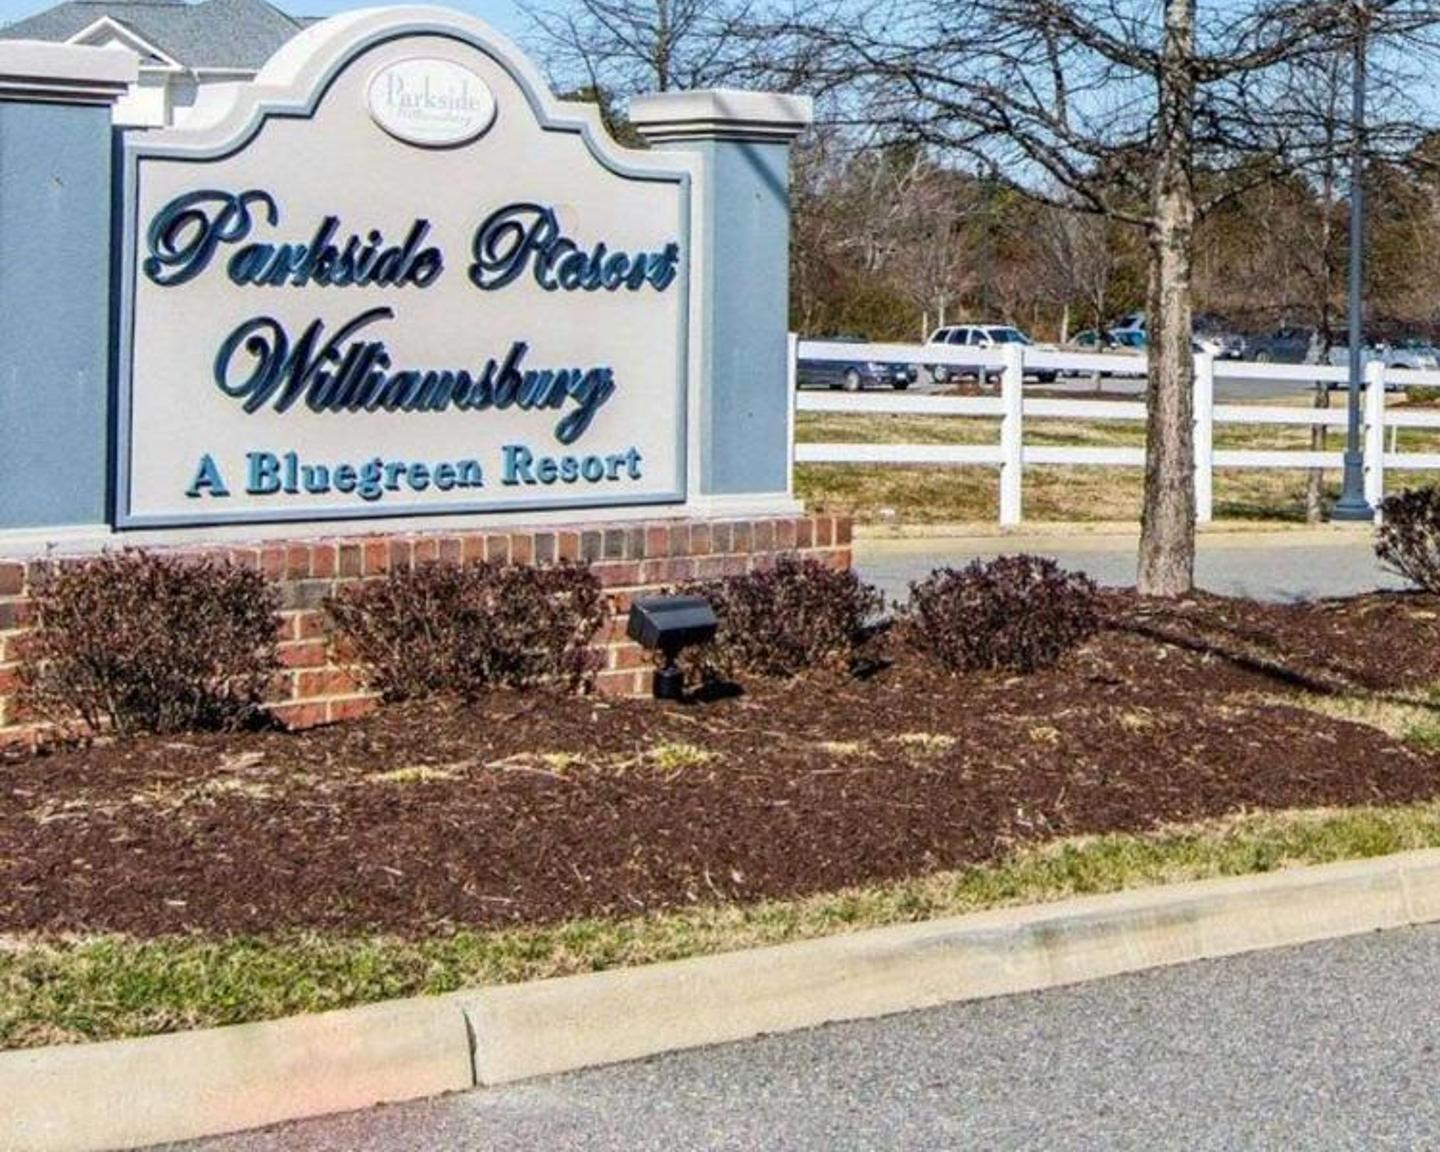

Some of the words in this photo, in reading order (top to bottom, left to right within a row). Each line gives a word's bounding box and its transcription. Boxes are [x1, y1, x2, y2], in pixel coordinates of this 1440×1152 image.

[386, 72, 480, 111] Parkside
[143, 190, 444, 287] Parkside
[468, 203, 679, 291] Resort
[213, 306, 616, 445] Williamsburg
[185, 452, 230, 497] A
[245, 450, 484, 500] Bluegreen
[500, 444, 642, 485] Resort
